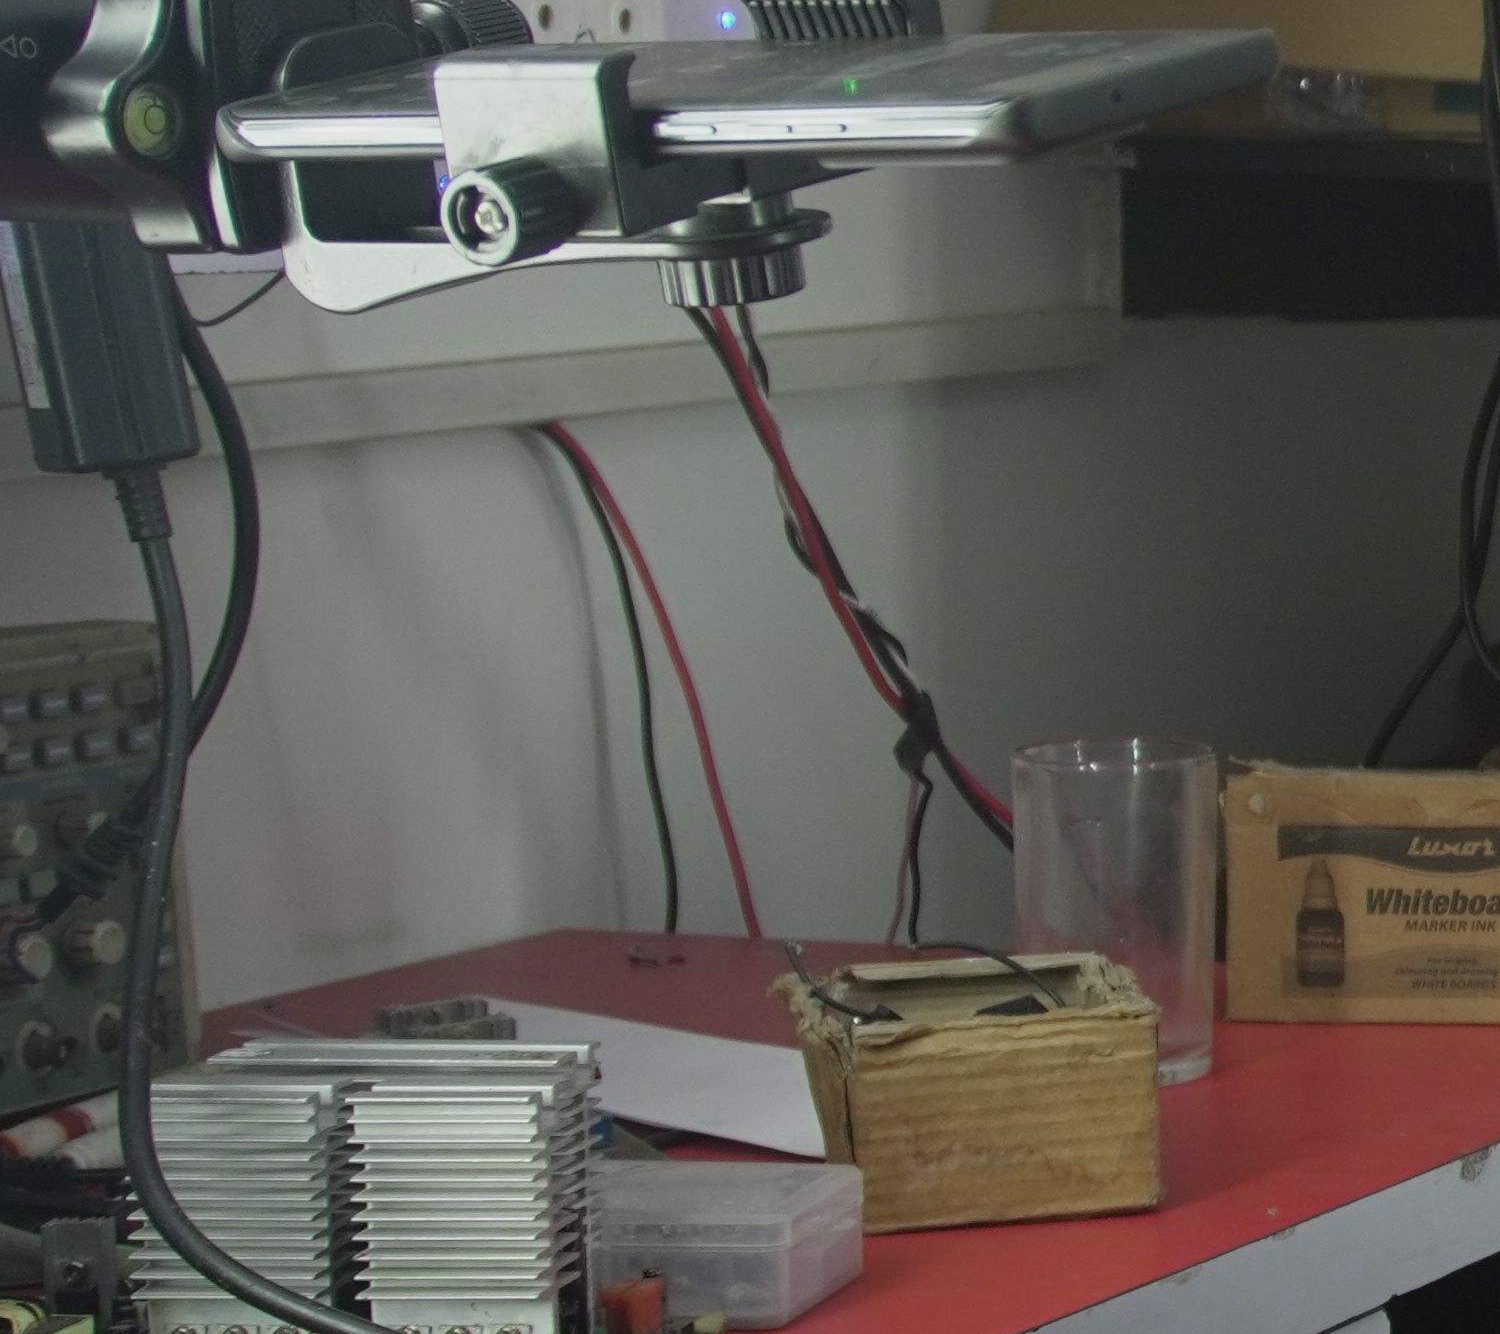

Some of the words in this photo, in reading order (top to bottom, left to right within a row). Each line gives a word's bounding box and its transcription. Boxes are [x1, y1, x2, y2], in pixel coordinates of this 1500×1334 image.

[1407, 835, 1495, 857] Luxor
[1404, 920, 1466, 932] MARKER
[1470, 920, 1497, 932] INK
